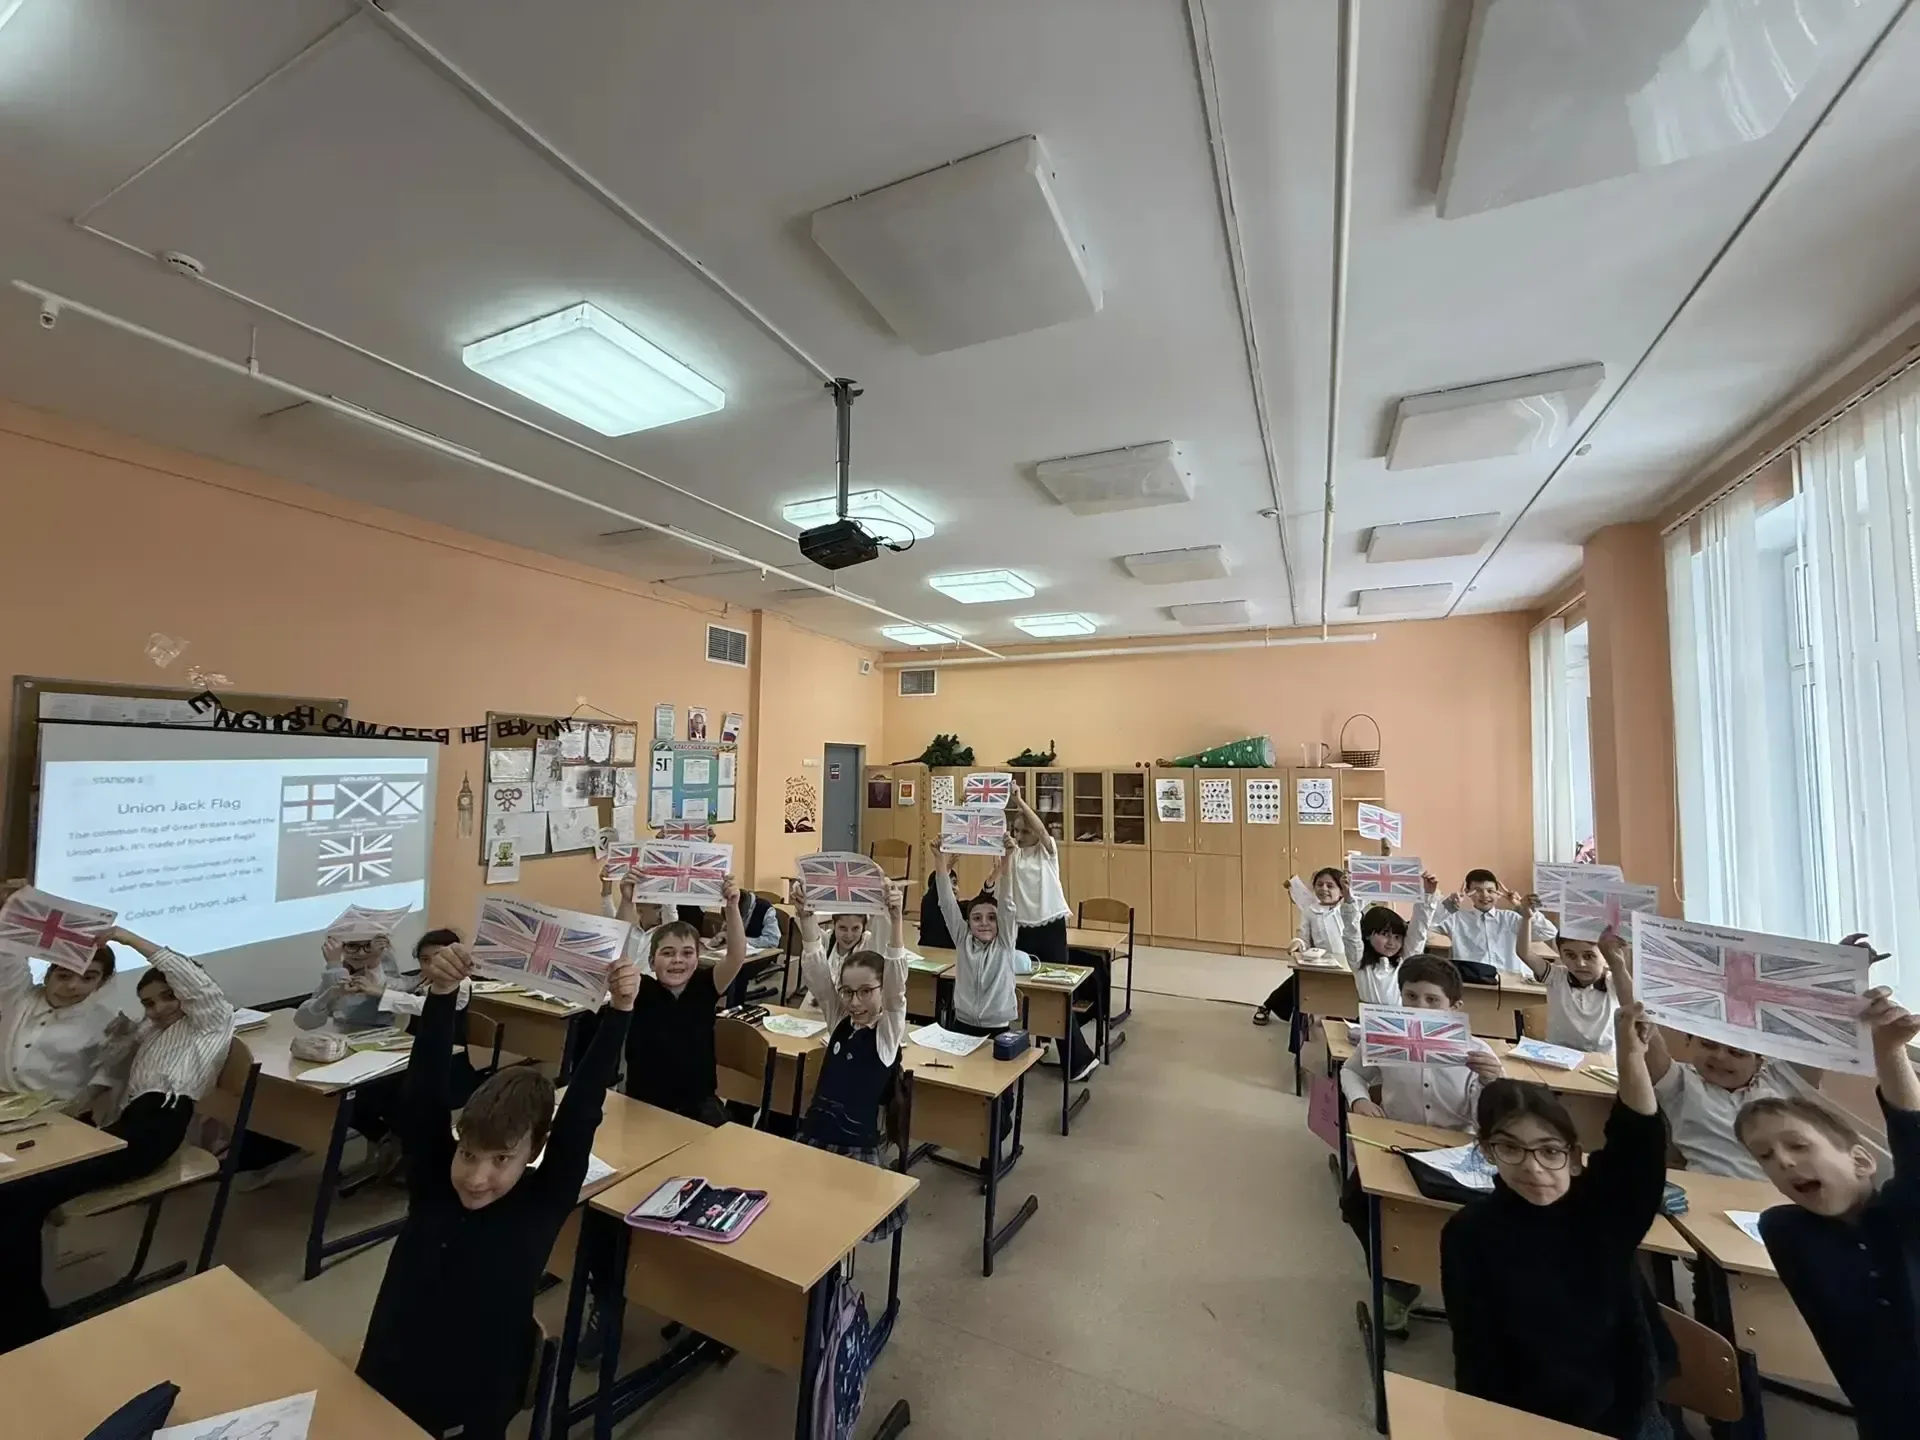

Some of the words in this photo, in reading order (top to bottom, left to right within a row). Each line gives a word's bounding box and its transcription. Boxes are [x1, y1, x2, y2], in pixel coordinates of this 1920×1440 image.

[322, 713, 378, 737] САМ
[461, 725, 487, 744] НЕ
[117, 803, 165, 814] Union
[171, 799, 205, 812] Jack
[211, 797, 241, 811] Flag
[140, 826, 158, 834] flag
[160, 824, 171, 832] of
[171, 822, 198, 831] Great
[199, 820, 228, 829] Britain
[237, 817, 261, 826] called
[176, 838, 187, 846] of
[124, 906, 165, 921] Colour
[168, 903, 187, 915] the
[189, 898, 221, 911] Union
[222, 893, 248, 906] Jack
